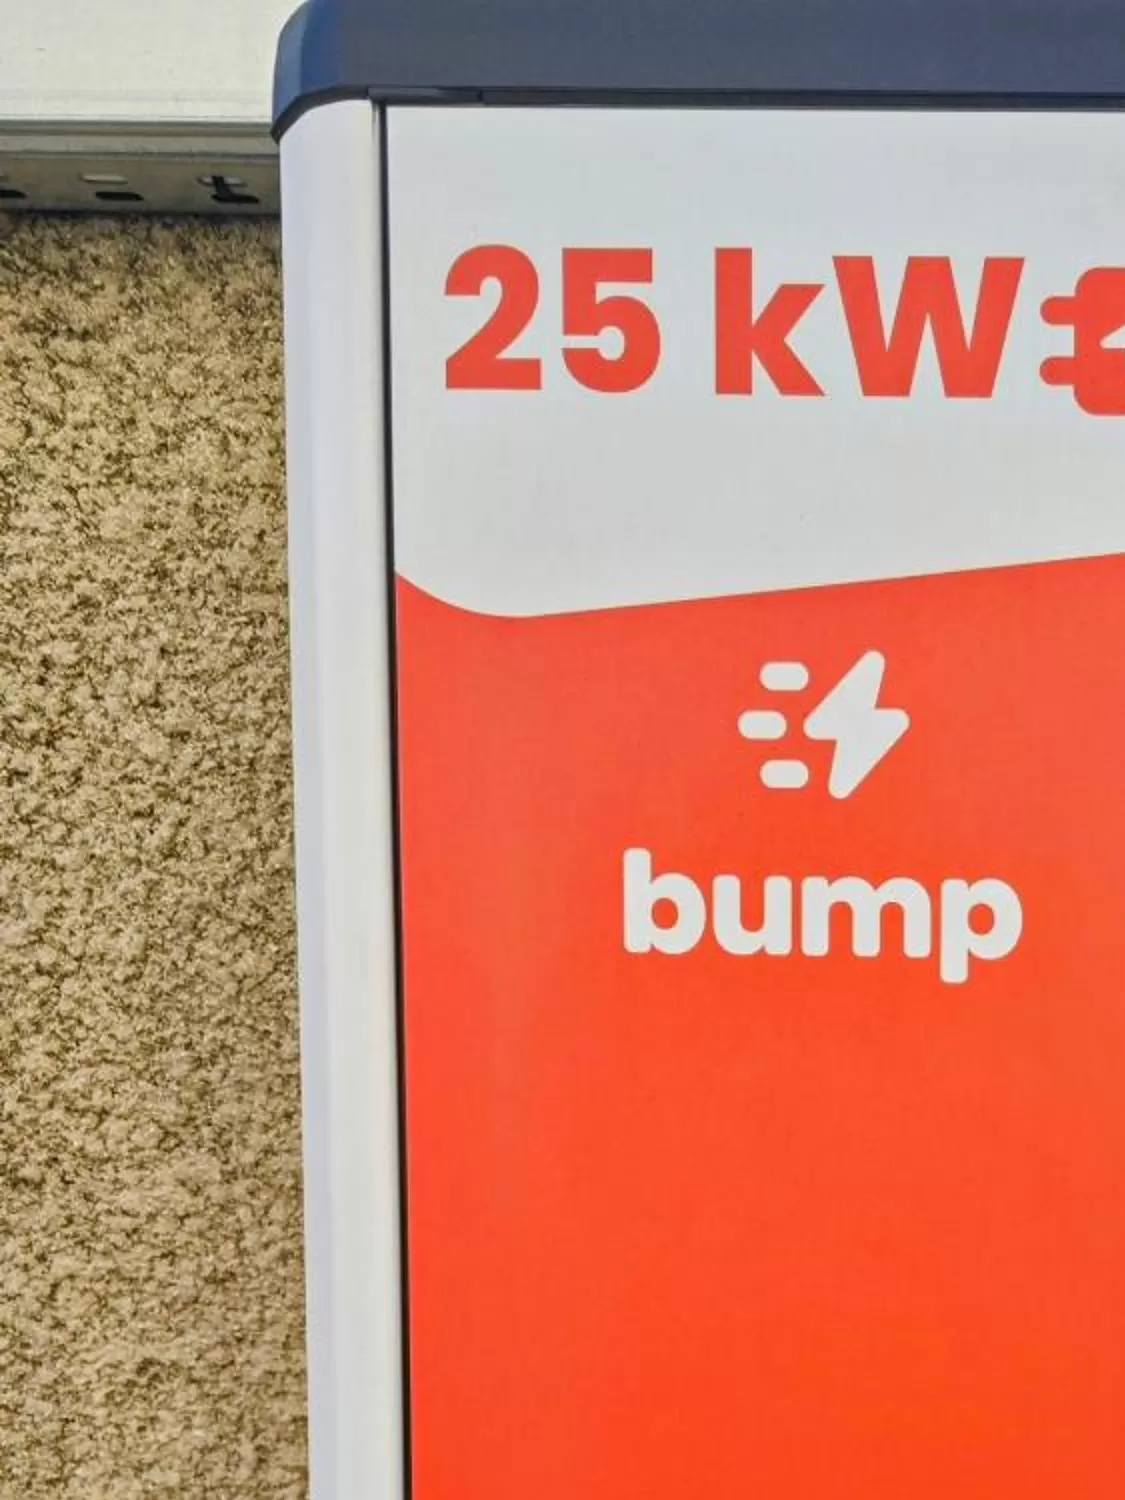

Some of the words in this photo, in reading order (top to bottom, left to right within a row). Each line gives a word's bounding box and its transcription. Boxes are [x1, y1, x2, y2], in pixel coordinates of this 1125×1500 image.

[445, 245, 660, 393] 25
[715, 248, 1024, 398] kW
[623, 848, 1023, 984] bump
